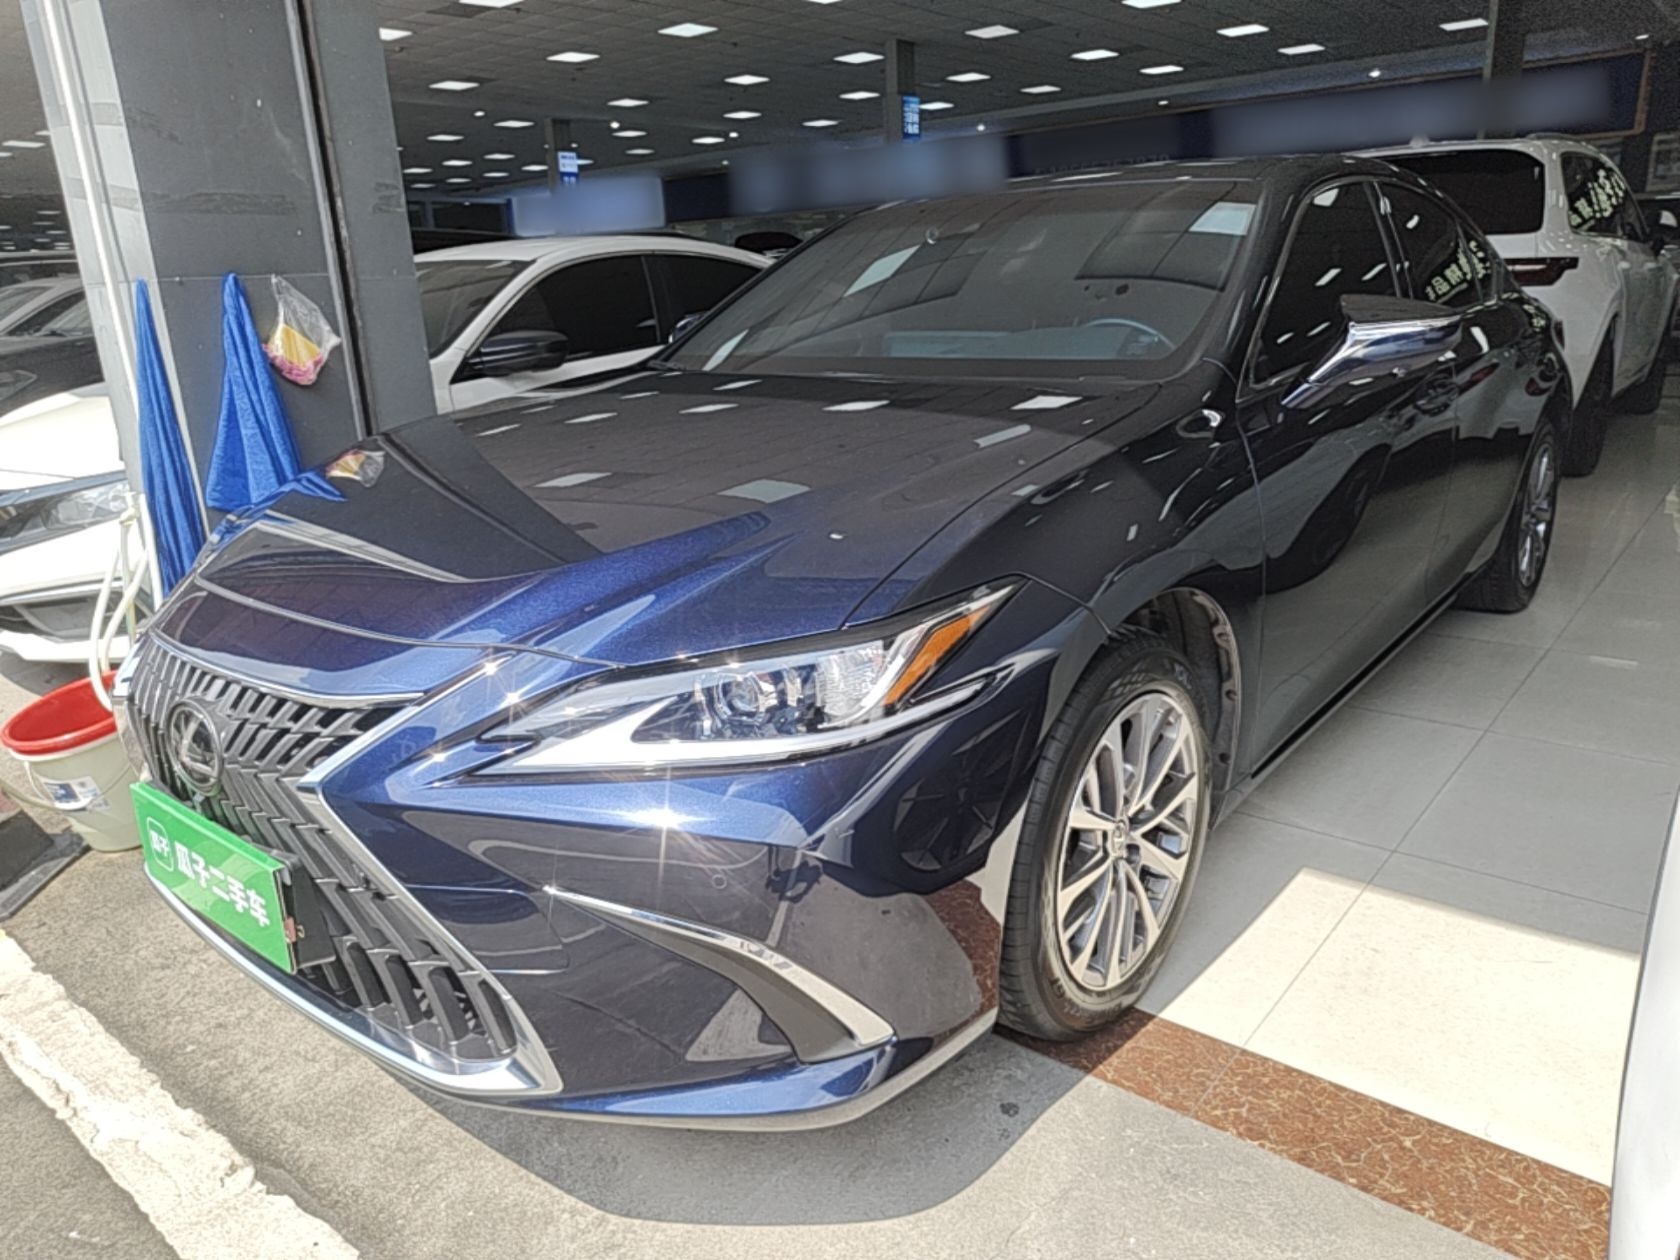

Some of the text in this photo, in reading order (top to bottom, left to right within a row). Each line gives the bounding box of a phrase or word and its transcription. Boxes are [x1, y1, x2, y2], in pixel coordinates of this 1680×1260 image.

[174, 840, 270, 927] 瓜子二手车
